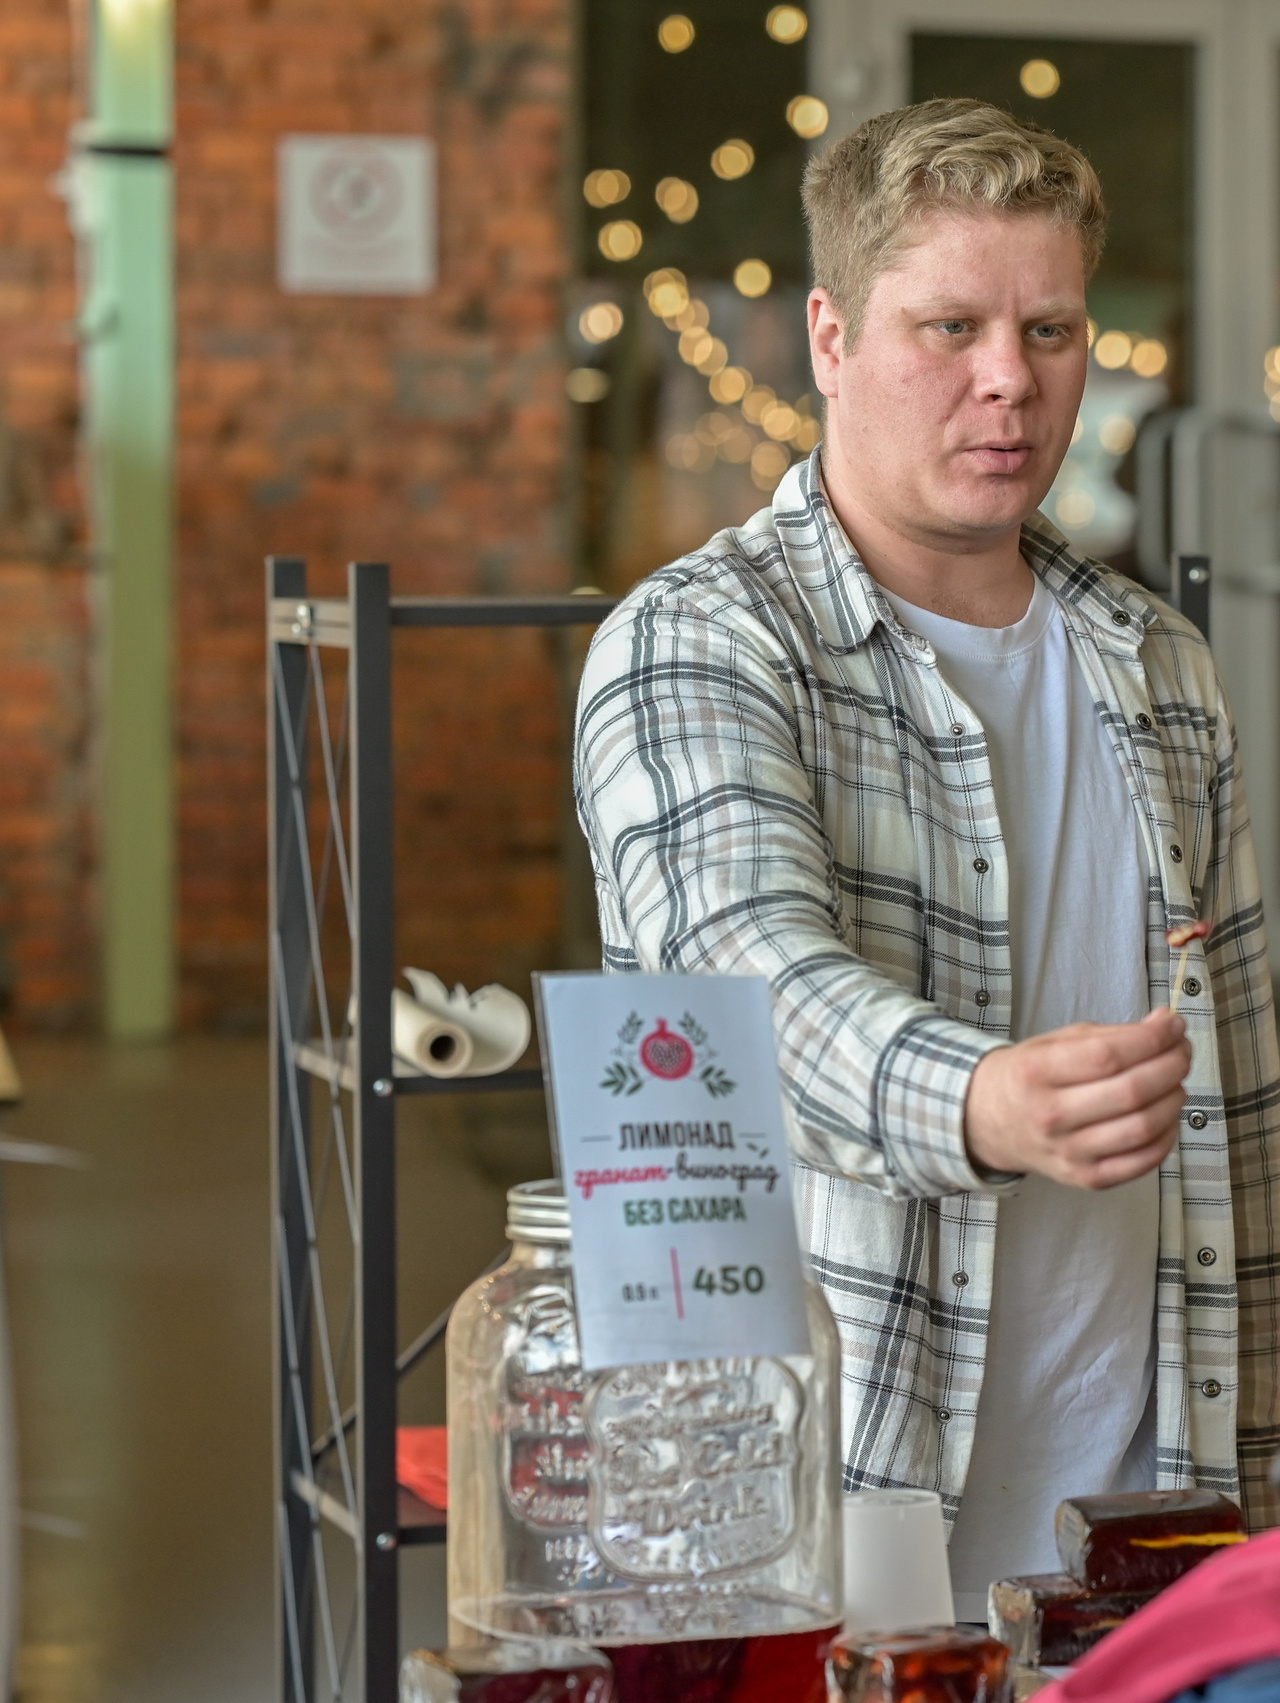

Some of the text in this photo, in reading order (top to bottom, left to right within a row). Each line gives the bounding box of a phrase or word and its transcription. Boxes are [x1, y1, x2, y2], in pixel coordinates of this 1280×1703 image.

[618, 1121, 736, 1151] ЛИМОНАД
[623, 1197, 747, 1227] БЕЗ САХАРА
[692, 1265, 765, 1296] 450
